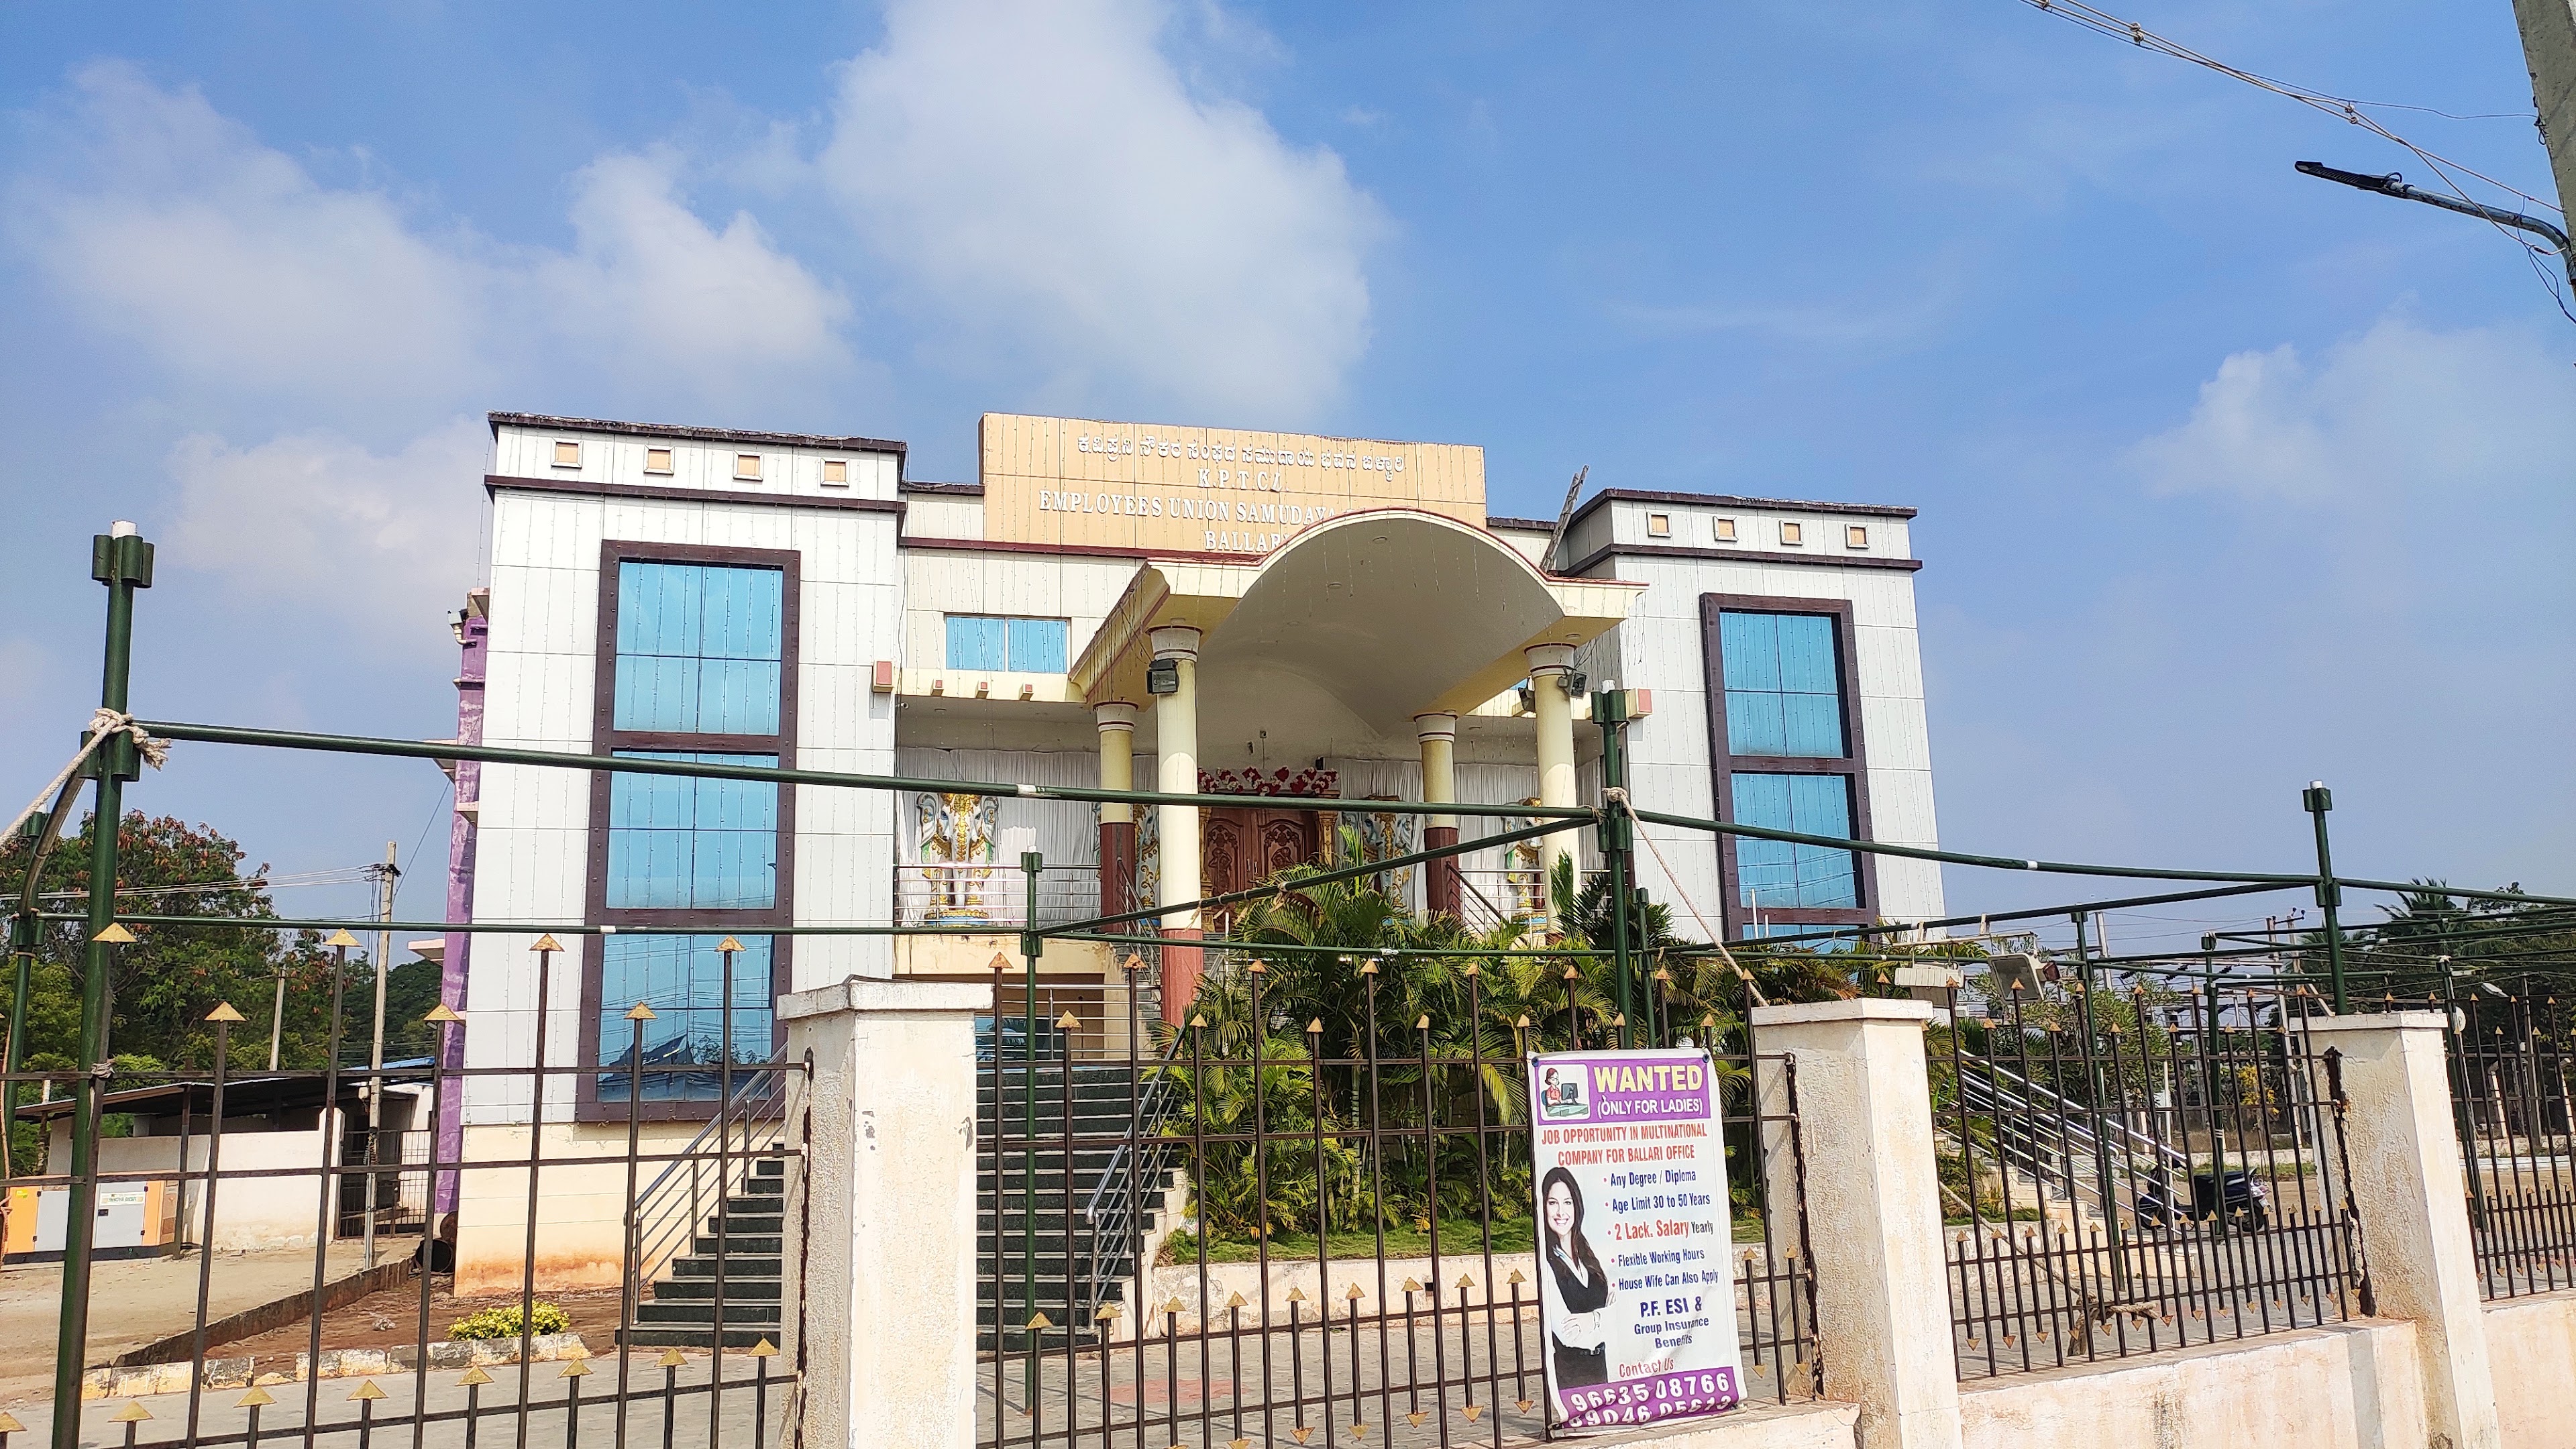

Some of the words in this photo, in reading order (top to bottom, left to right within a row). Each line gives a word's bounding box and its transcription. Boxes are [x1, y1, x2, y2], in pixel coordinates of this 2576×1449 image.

[1139, 435, 1182, 458] ನೌಕರ
[1187, 439, 1236, 464] ಸಂಘದ
[1242, 443, 1315, 466] ಸಮುದಾಯ
[1321, 449, 1356, 470] ಭವನ
[1362, 455, 1404, 482] ಬಳ್ಳಾರಿ
[1039, 490, 1163, 517] EMPLOYEES
[1169, 497, 1230, 521] UNION
[1594, 1065, 1703, 1093] WANTED
[1598, 1100, 1632, 1119] (ONLY
[1635, 1099, 1658, 1114] FOR
[1661, 1097, 1703, 1115] LADIES)
[1542, 1129, 1560, 1144] JOB
[1564, 1126, 1627, 1143] OPPORTUNITY
[1630, 1126, 1638, 1140] IN
[1641, 1123, 1707, 1140] MULTINATIONAL
[1558, 1149, 1603, 1165] COMPANY
[1607, 1148, 1625, 1163] FOR
[1628, 1146, 1663, 1162] BALLARI
[1666, 1144, 1695, 1159] OFFICE
[1611, 1173, 1626, 1189] Any
[1629, 1172, 1657, 1187] Degree
[1665, 1169, 1696, 1185] Diploma
[1613, 1198, 1629, 1214] Age
[1631, 1196, 1651, 1210] Limit
[1653, 1195, 1664, 1208] 30
[1667, 1195, 1675, 1208] to
[1678, 1193, 1688, 1207] 50
[1689, 1193, 1711, 1205] Years
[1615, 1223, 1622, 1240] 2
[1625, 1221, 1654, 1240] Lack.
[1656, 1219, 1688, 1238] Salary
[1690, 1220, 1713, 1235] Yearly
[1618, 1252, 1648, 1267] Flexible
[1649, 1250, 1680, 1264] Working
[1682, 1248, 1705, 1260] Hours
[1619, 1278, 1642, 1291] House
[1644, 1275, 1662, 1288] Wife
[1665, 1273, 1680, 1286] Can
[1682, 1272, 1699, 1284] Also
[1702, 1269, 1719, 1285] Apply
[1666, 1297, 1689, 1315] ESI
[1695, 1295, 1703, 1311] &
[1634, 1324, 1662, 1335] Group
[1665, 1318, 1709, 1331] Insurance
[1655, 1334, 1693, 1348] Benefits
[1619, 1359, 1661, 1377] Contact
[1664, 1357, 1674, 1371] Us
[1570, 1383, 1650, 1411] 96635
[1655, 1373, 1729, 1399] 08766
